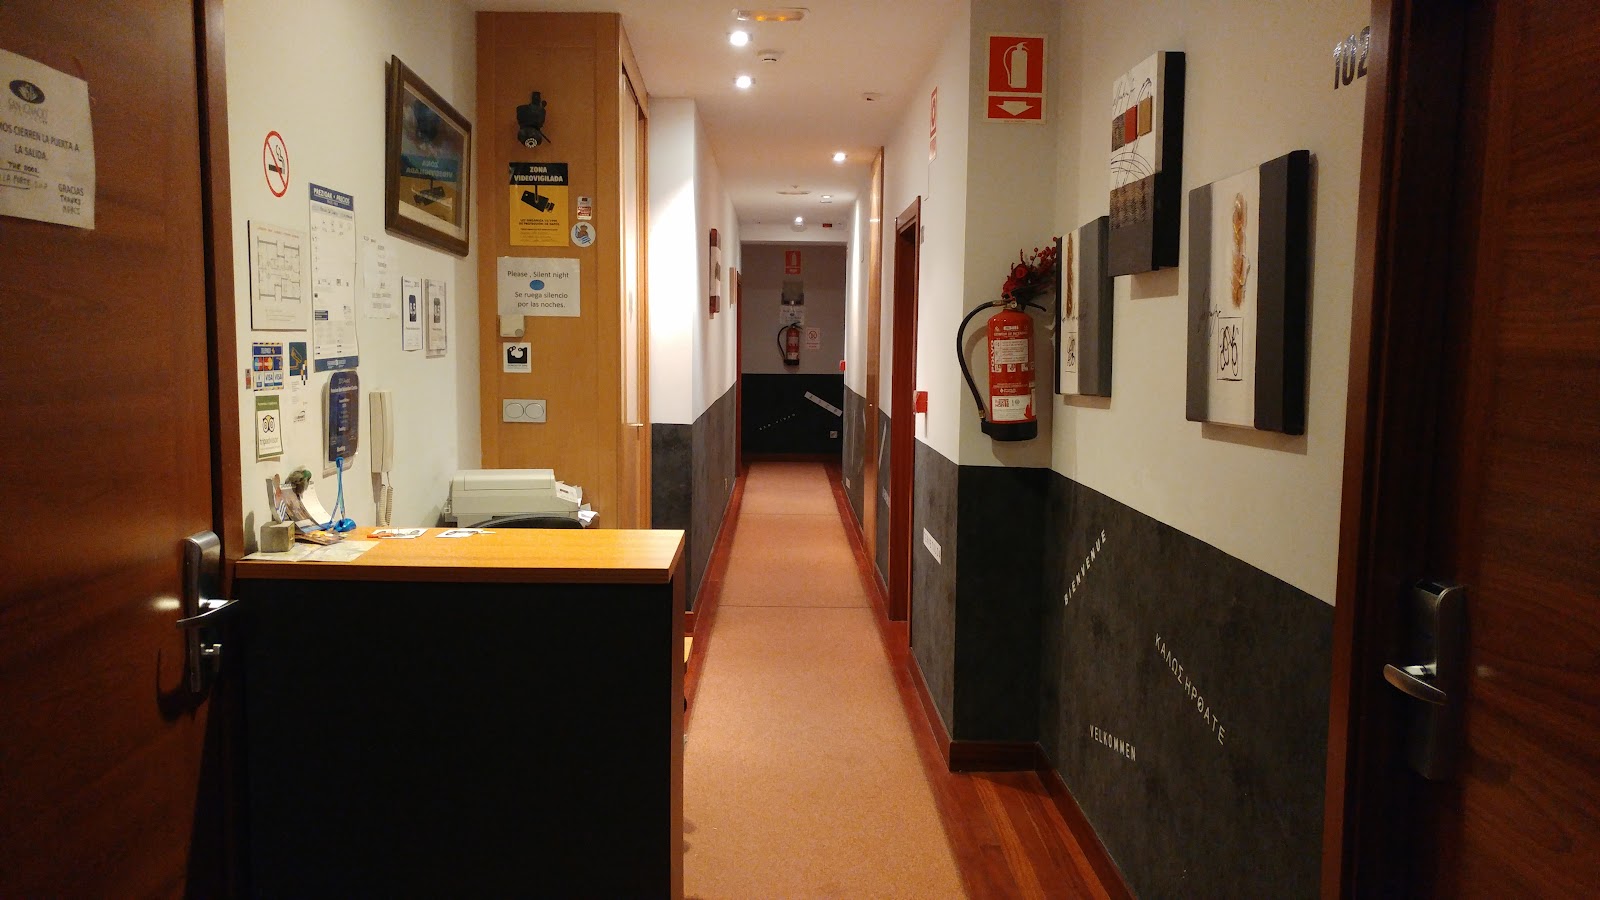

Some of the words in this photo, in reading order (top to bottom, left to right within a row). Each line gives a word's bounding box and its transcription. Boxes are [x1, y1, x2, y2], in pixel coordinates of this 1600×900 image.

[1333, 26, 1370, 90] 102
[14, 126, 41, 142] CIERREN
[51, 137, 74, 151] PUERTA
[14, 144, 23, 154] LA
[530, 166, 548, 174] ZONA
[514, 175, 564, 183] VIDEOVIGILADA
[58, 183, 84, 196] GRACIAS
[552, 271, 569, 279] night
[544, 291, 568, 299] silencio
[1064, 529, 1107, 606] BIENVENUE
[1089, 724, 1136, 762] VELKOMMEN
